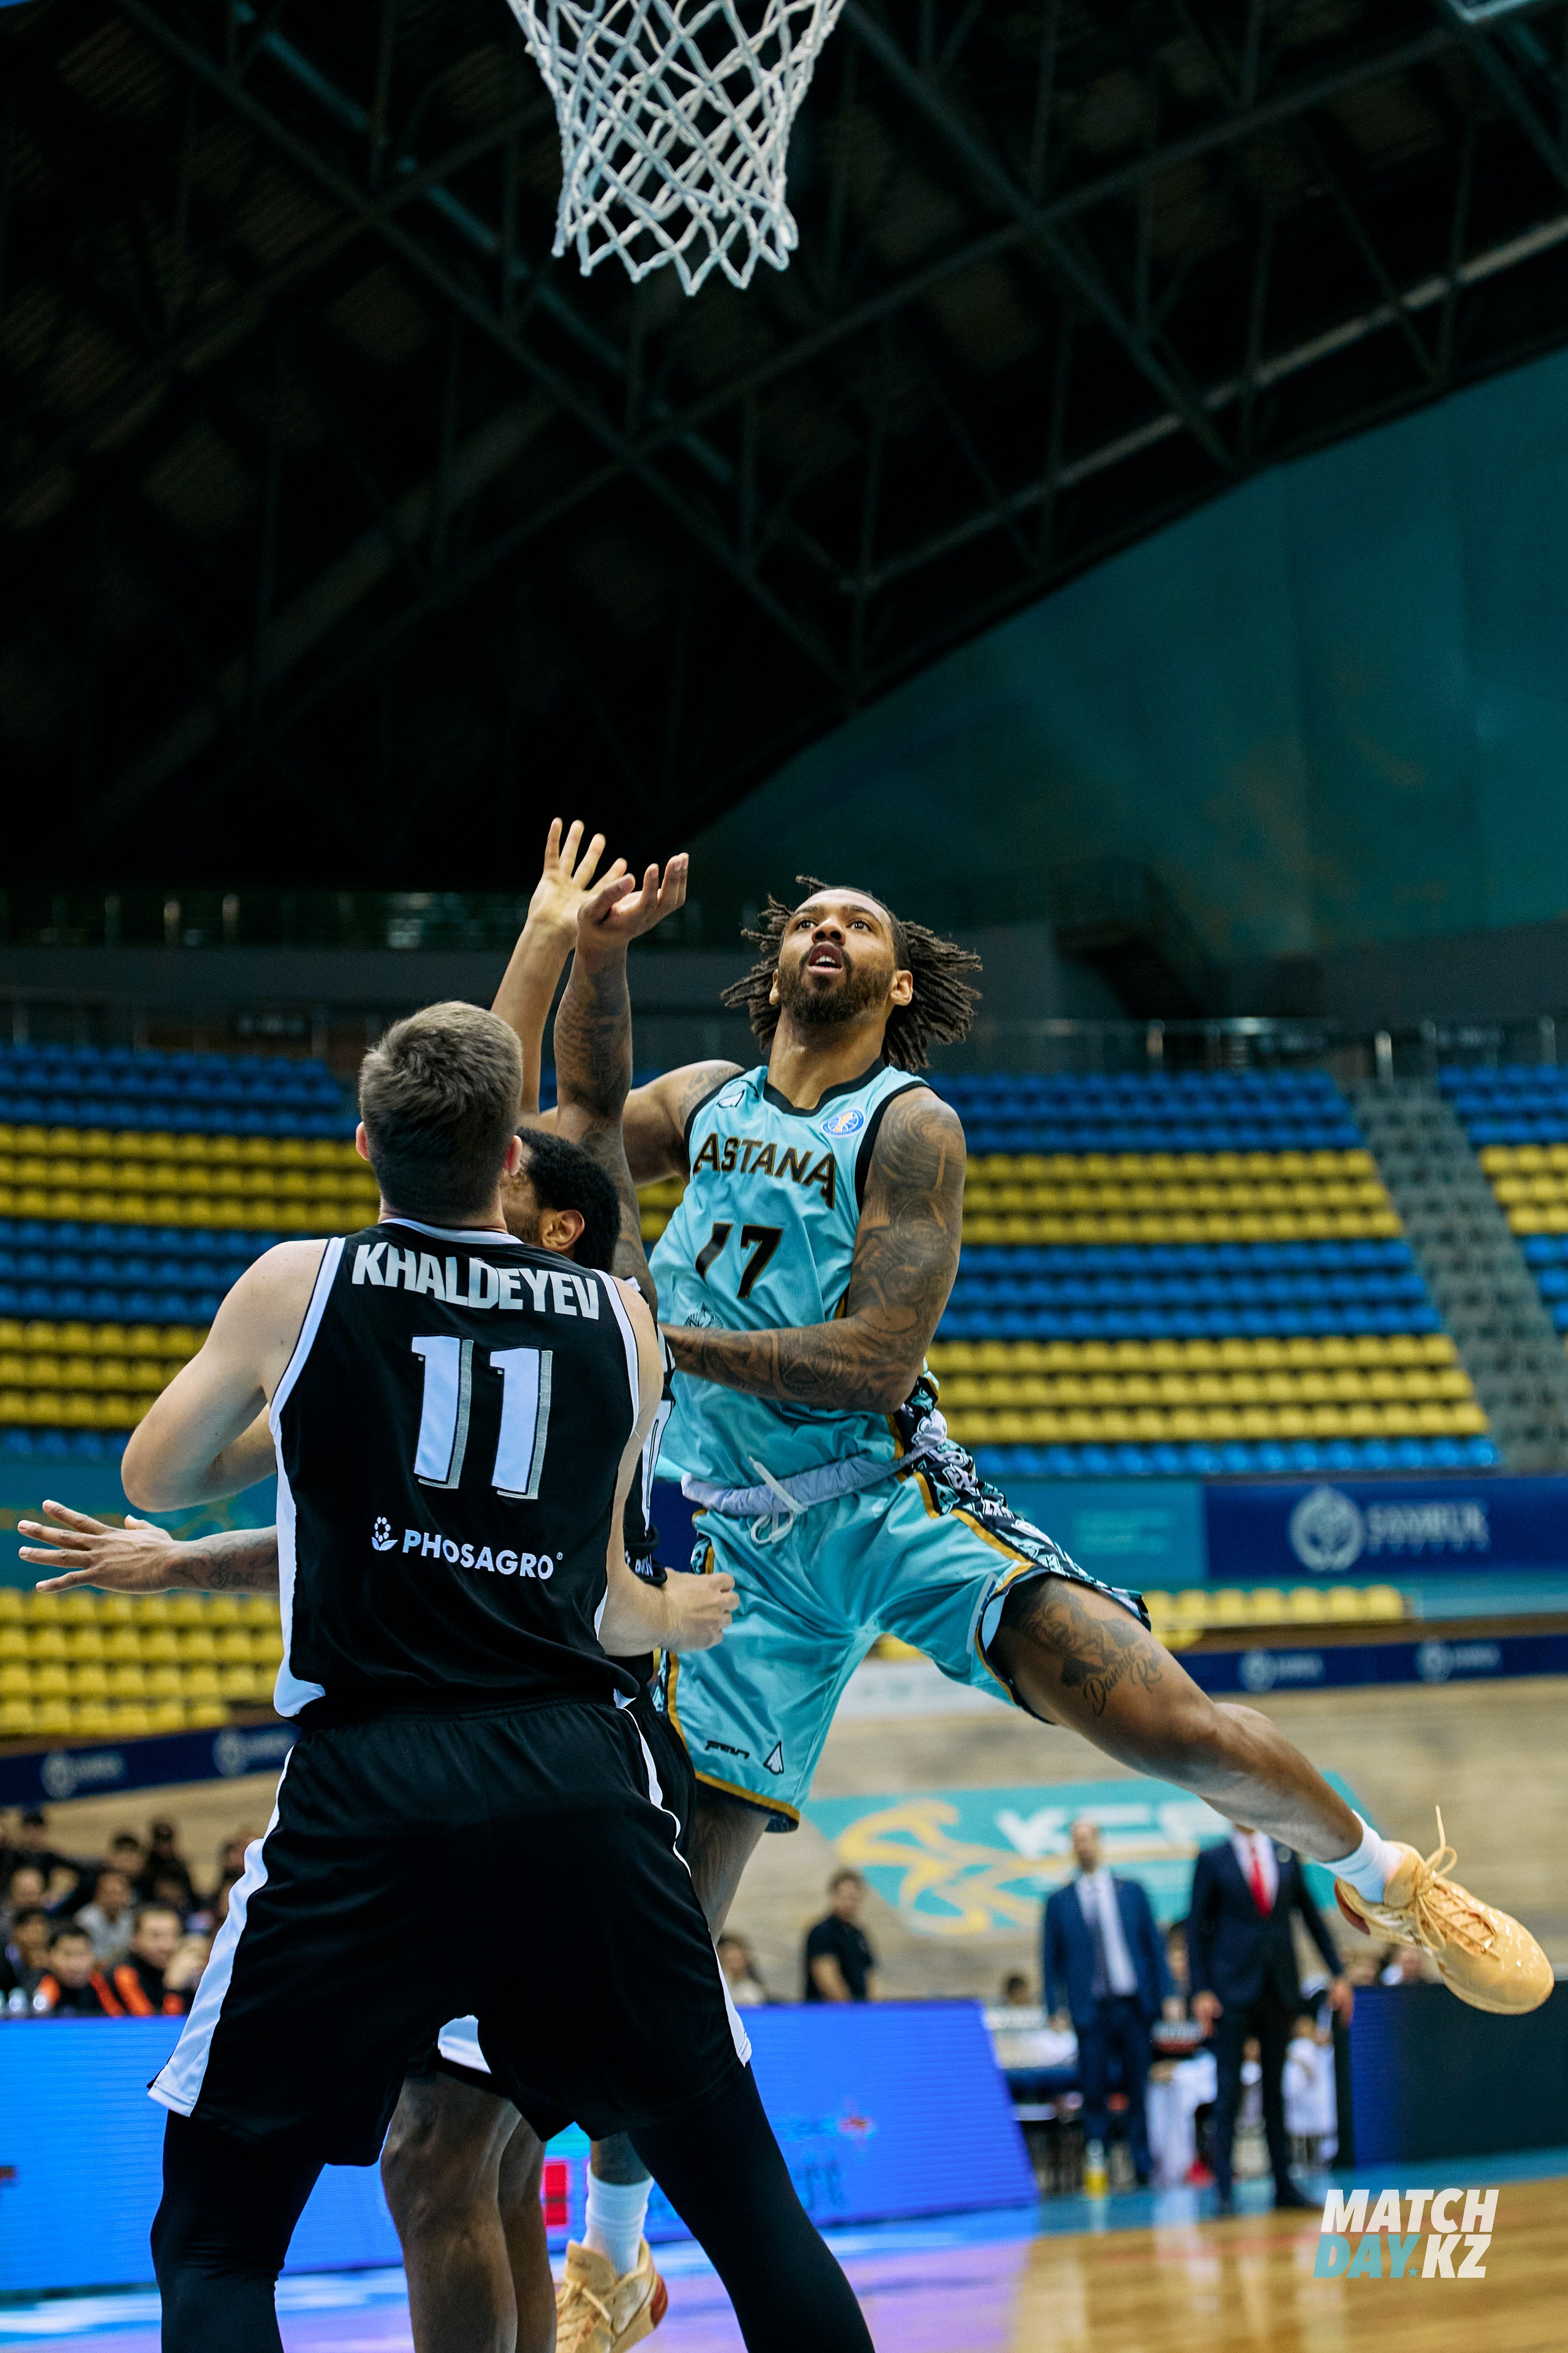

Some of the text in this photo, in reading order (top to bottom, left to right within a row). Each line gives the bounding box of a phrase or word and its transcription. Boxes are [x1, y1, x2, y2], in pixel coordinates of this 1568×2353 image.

[693, 1133, 837, 1210] ASTANA
[352, 1242, 600, 1320] KHALDEYEV
[695, 1223, 783, 1299] 17
[411, 1334, 553, 1500] 11
